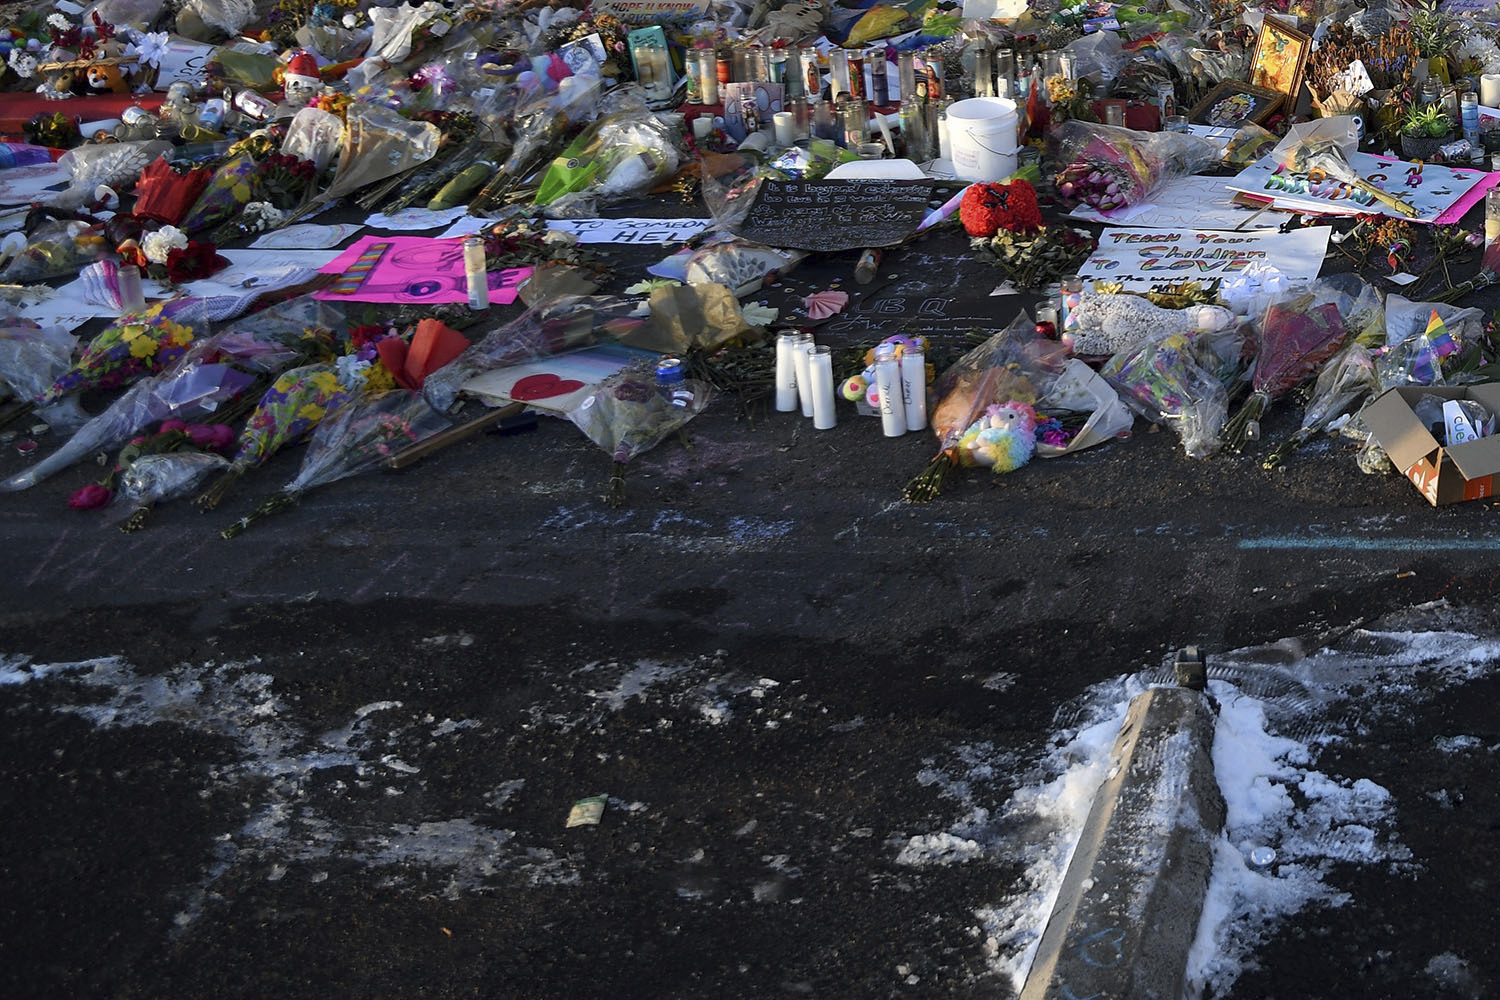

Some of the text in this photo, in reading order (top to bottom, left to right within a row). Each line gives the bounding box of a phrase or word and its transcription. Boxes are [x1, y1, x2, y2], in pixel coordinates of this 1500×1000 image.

[656, 2, 695, 12] KNOW
[611, 231, 686, 242] HEL
[1139, 259, 1251, 273] LOVE
